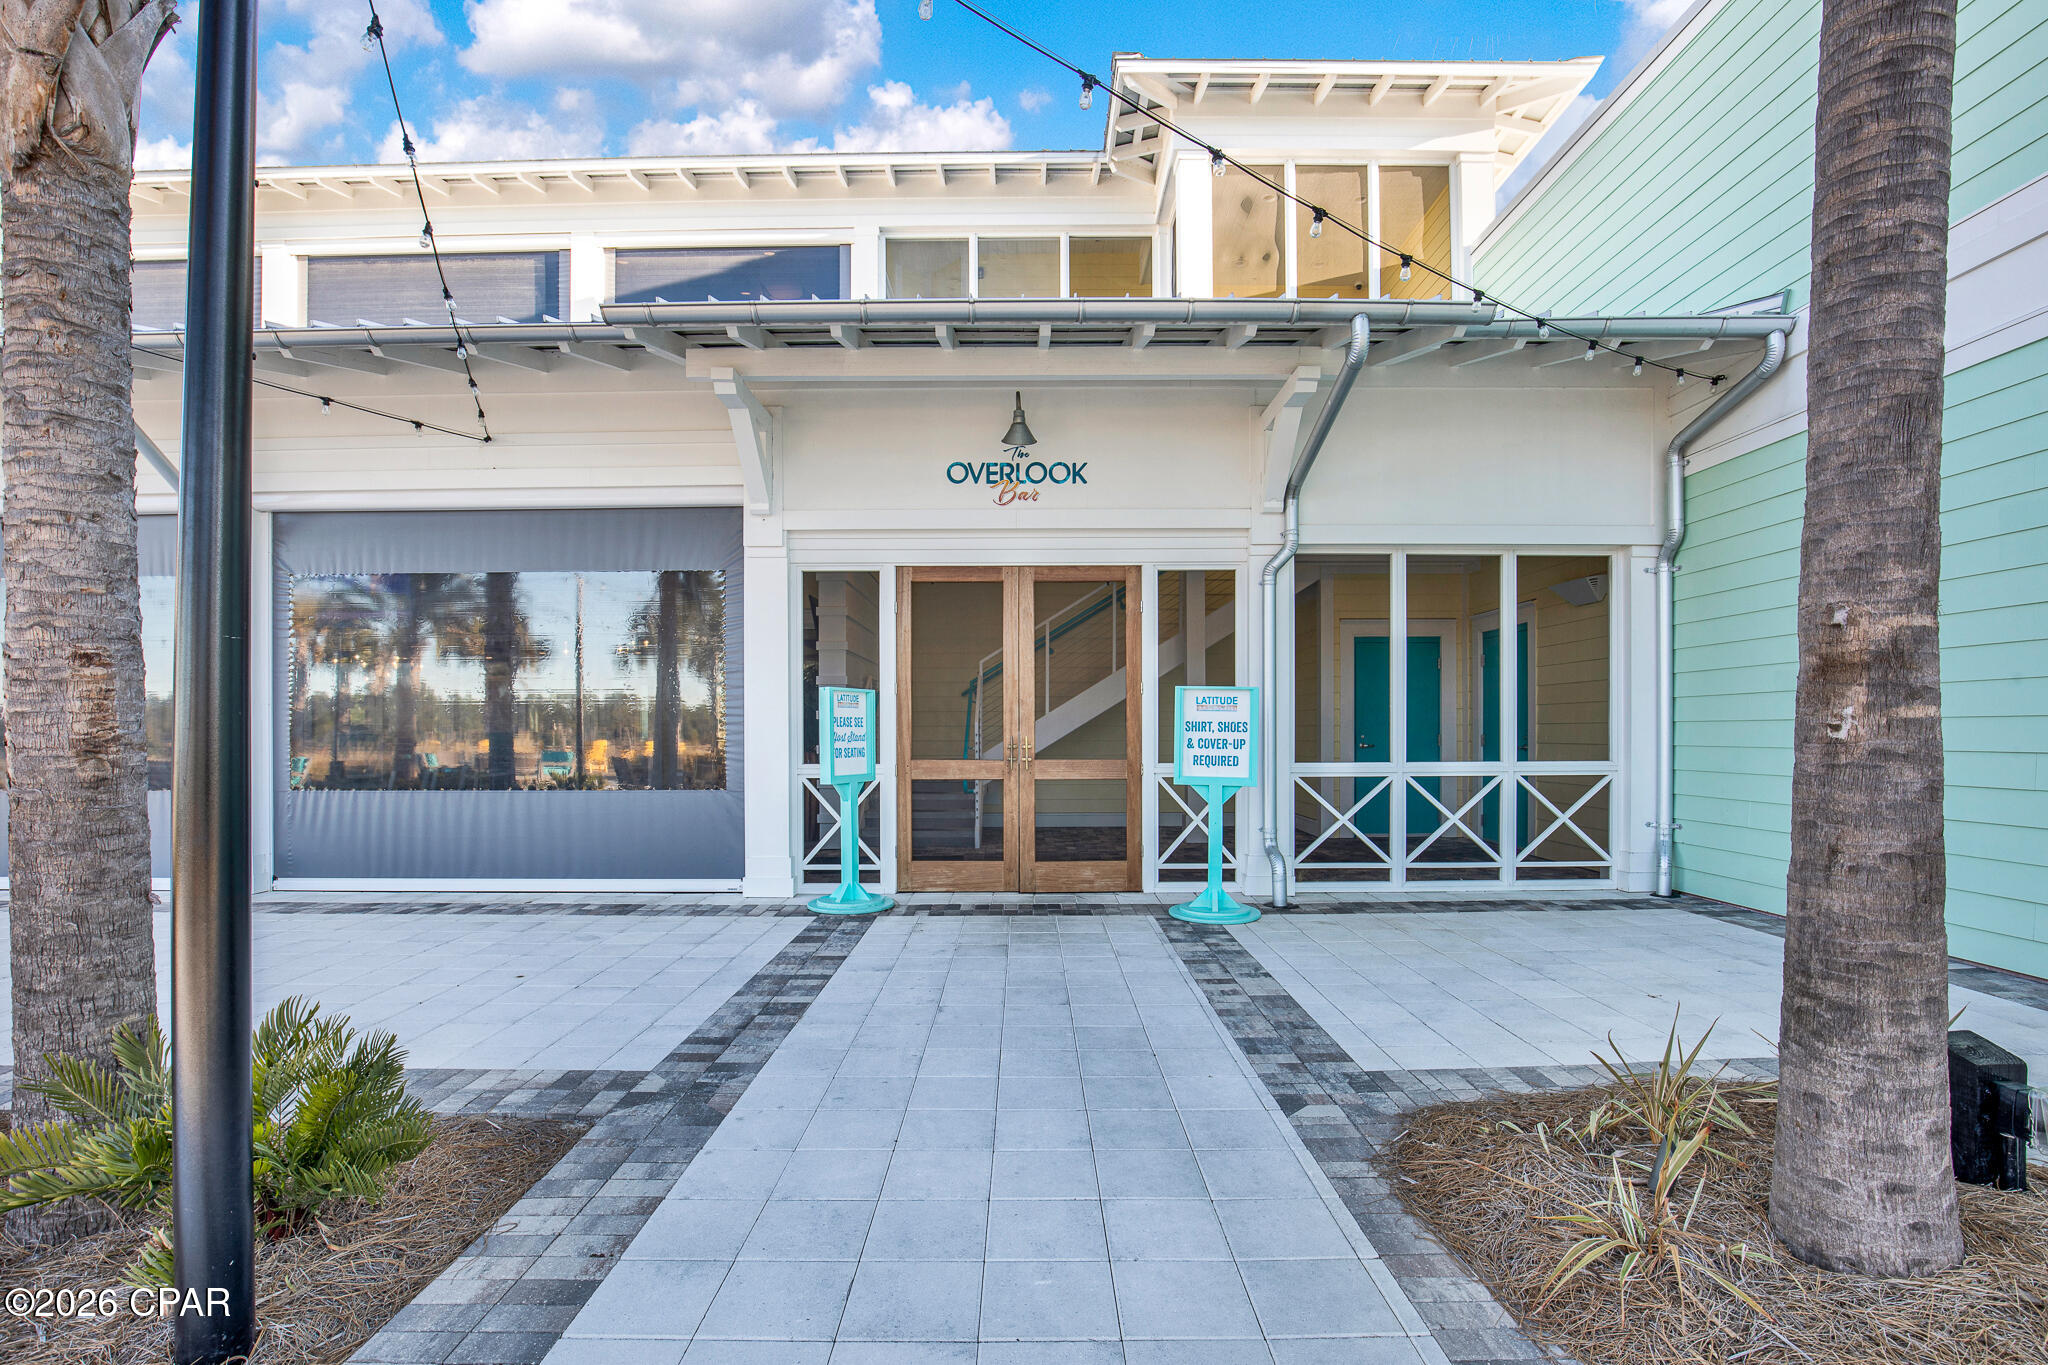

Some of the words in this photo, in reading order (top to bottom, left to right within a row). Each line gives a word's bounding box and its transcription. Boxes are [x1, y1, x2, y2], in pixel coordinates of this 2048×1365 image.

[1003, 445, 1029, 461] The
[946, 461, 1088, 485] OVERLOOK
[990, 479, 1040, 506] Bar
[837, 694, 859, 703] LATITUDE
[1195, 696, 1238, 705] LATITUDE
[853, 717, 864, 727] SEE
[1184, 720, 1214, 734] SHIRT,
[1217, 721, 1248, 733] SHOES
[1186, 737, 1195, 749] &
[1197, 738, 1246, 750] COVER-UP
[843, 747, 866, 758] SEATING
[1192, 754, 1239, 768] REQUIRED
